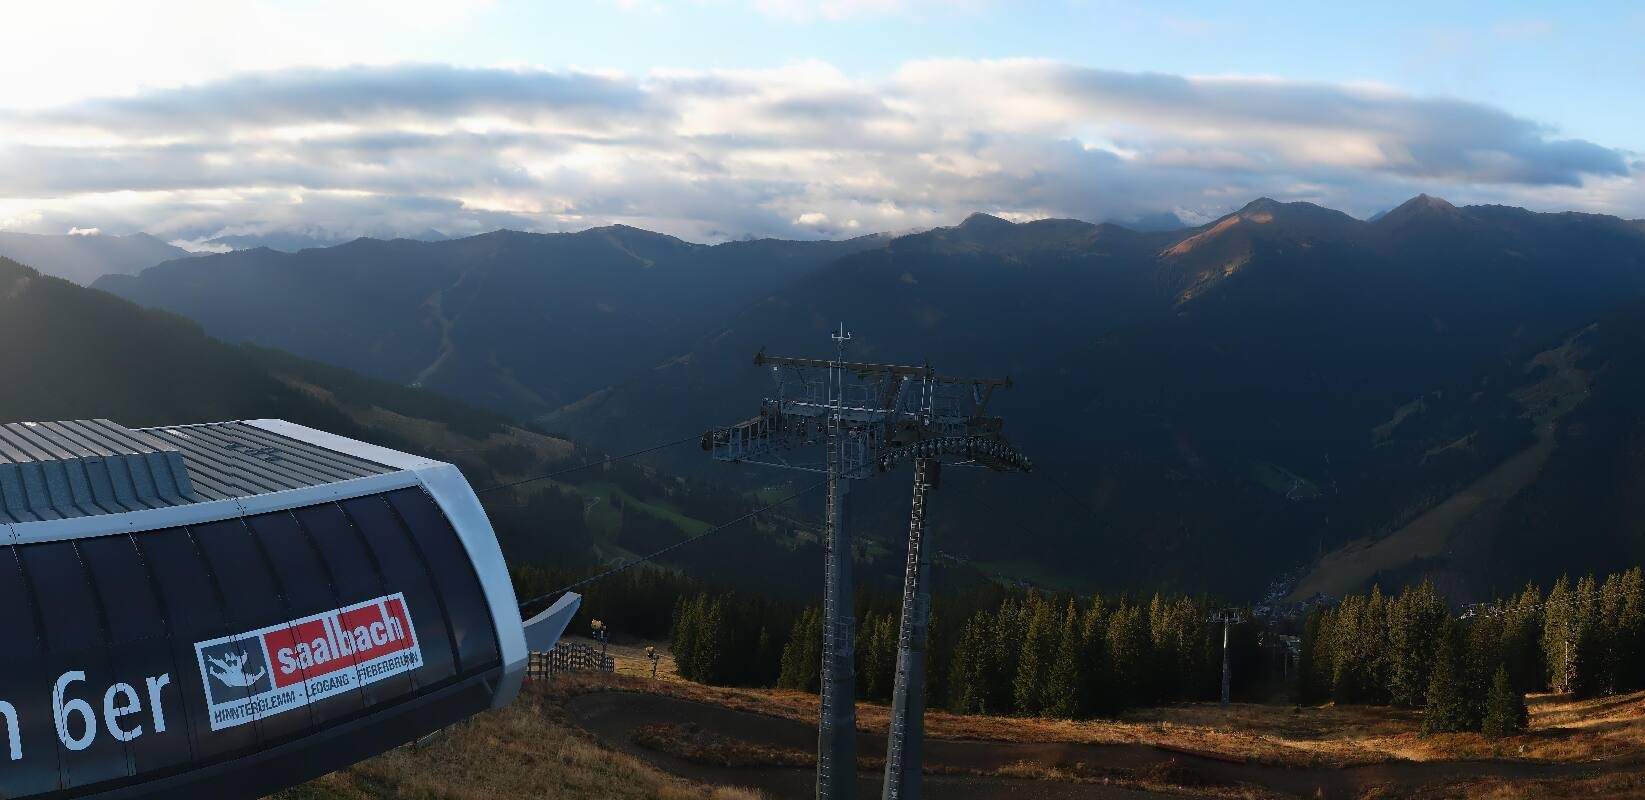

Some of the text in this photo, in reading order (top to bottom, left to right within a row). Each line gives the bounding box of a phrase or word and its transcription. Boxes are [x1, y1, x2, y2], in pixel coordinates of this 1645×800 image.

[277, 601, 405, 676] saalbach
[52, 670, 171, 751] 6er
[214, 650, 419, 723] HINTERGLEMM LEOGANG FIEBERBRUNN
